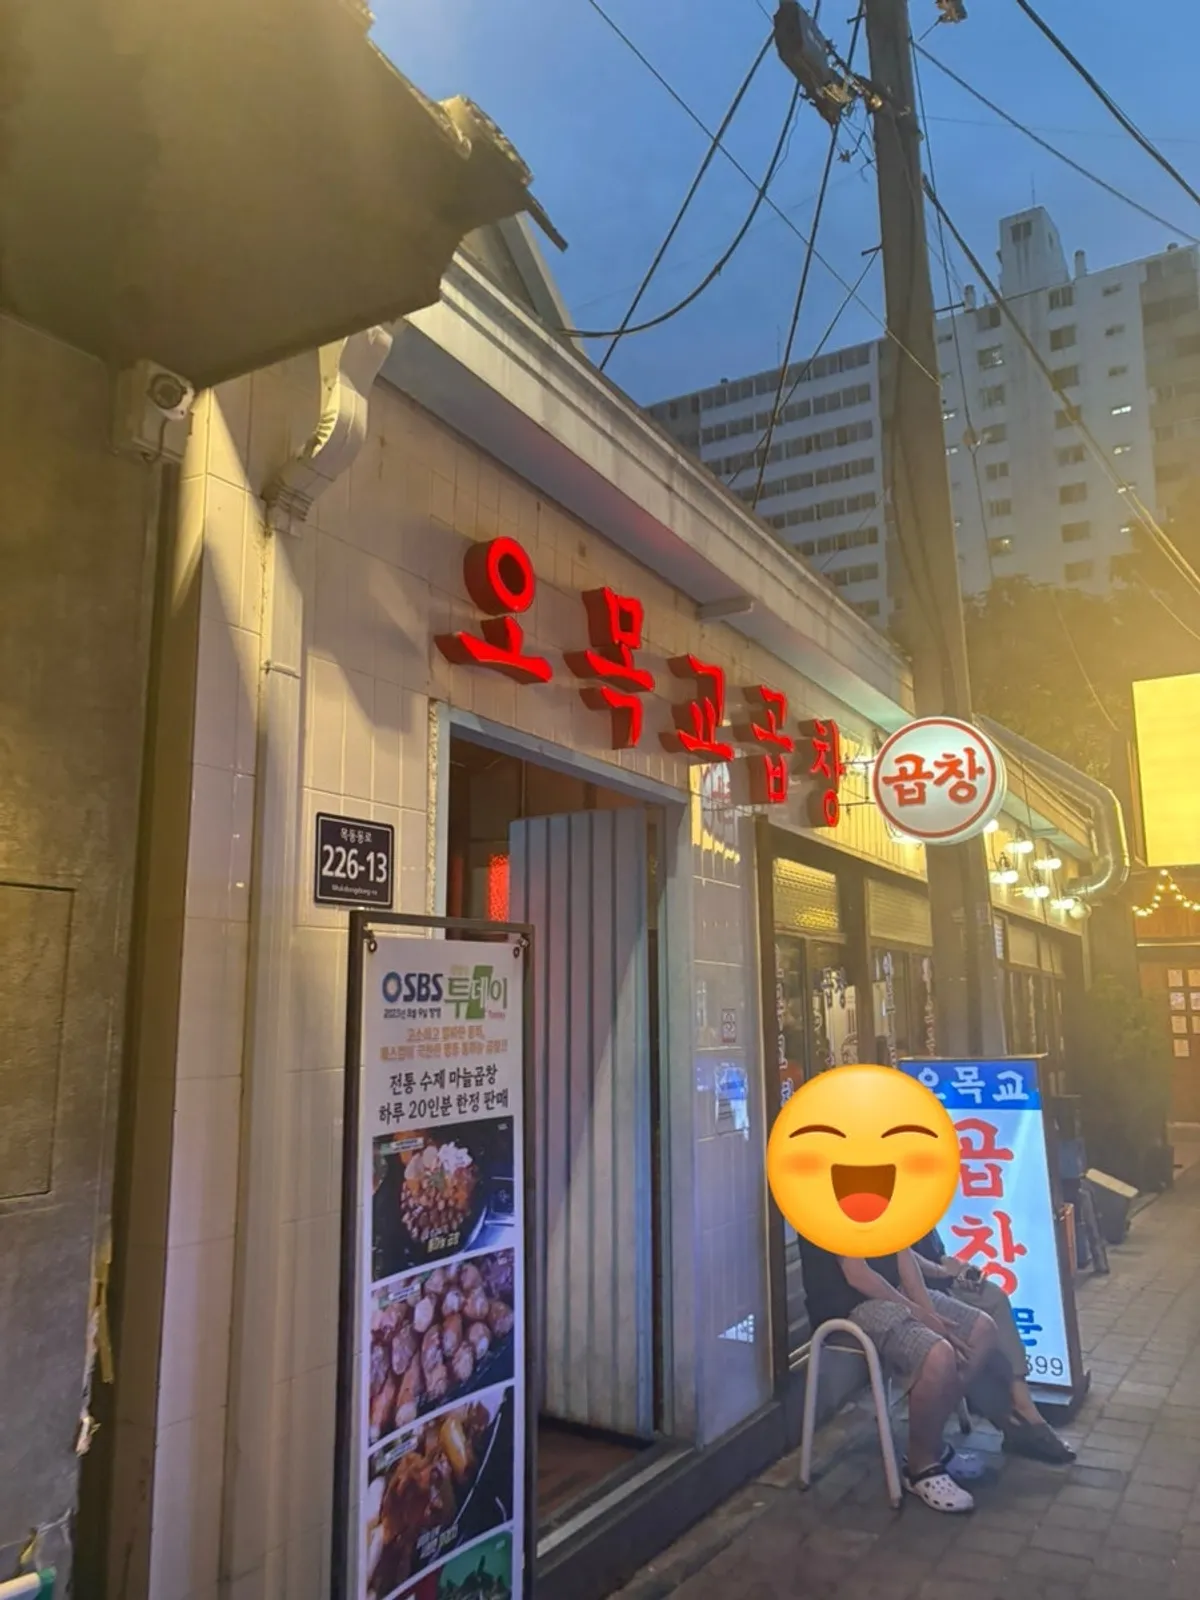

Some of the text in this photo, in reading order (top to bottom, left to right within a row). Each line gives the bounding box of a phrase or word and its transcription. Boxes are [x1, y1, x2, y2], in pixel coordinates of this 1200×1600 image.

[882, 747, 985, 807] 곱창
[322, 844, 388, 883] 226-13
[403, 973, 443, 1003] SBS
[444, 974, 508, 1019] 투데이
[390, 1063, 498, 1096] 전통 수제 마늘곱창
[379, 1088, 509, 1126] 하루 20인분 한정 판매
